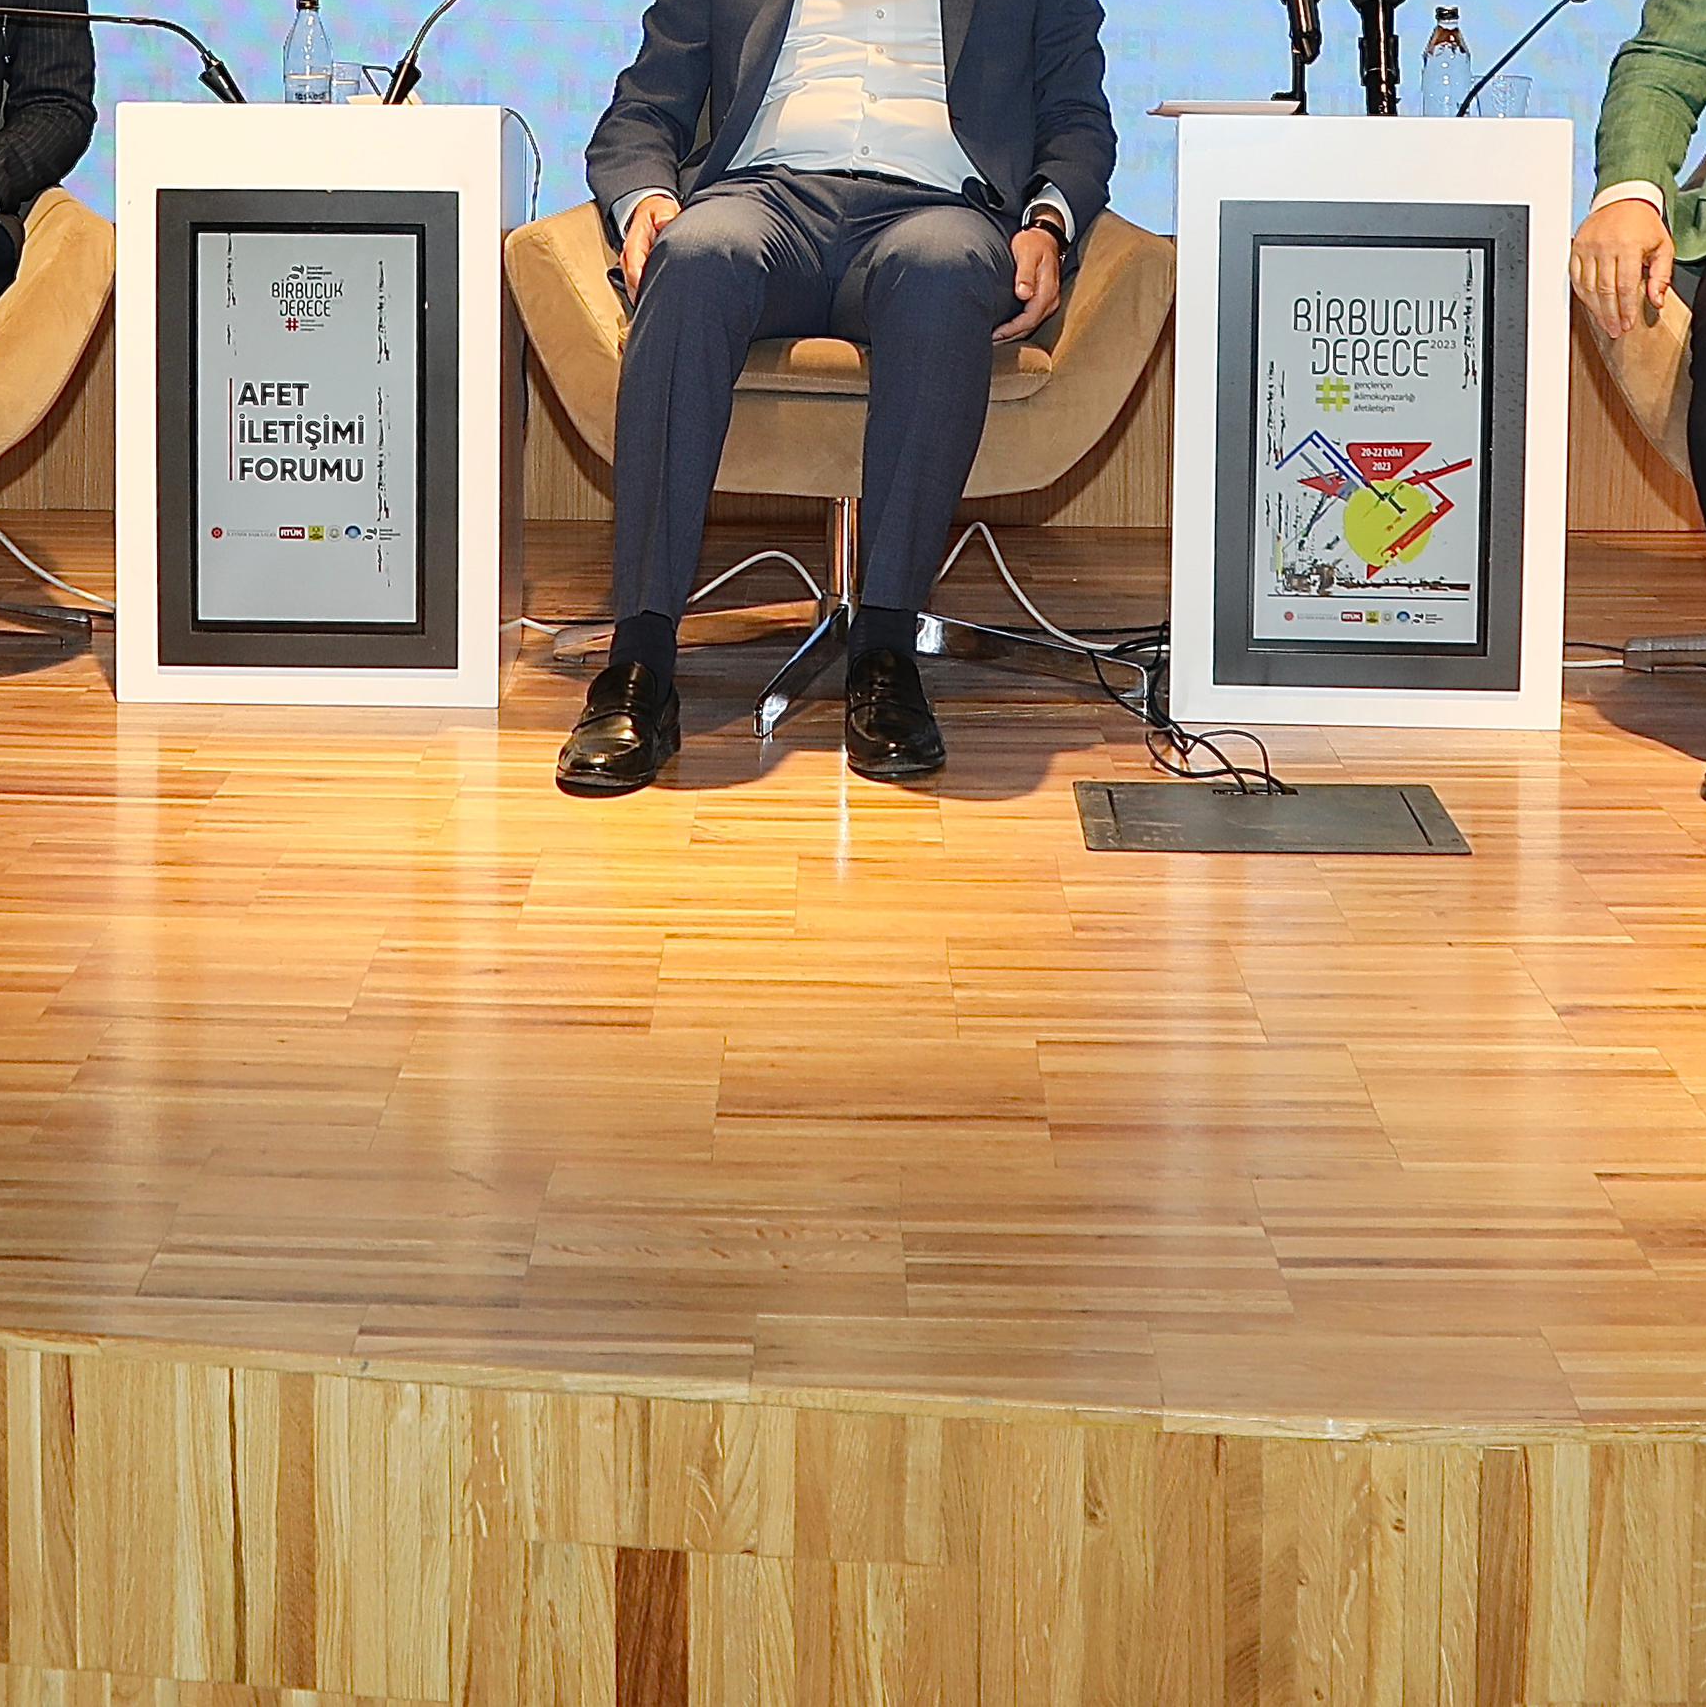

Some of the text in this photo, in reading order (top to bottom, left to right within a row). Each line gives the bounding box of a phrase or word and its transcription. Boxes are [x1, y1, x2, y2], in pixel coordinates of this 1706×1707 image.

[1430, 340, 1457, 350] 2023
[237, 382, 310, 406] AFET
[239, 413, 365, 450] İLETİŞİMİ
[239, 457, 364, 482] FORUMU
[1372, 461, 1392, 471] 2023
